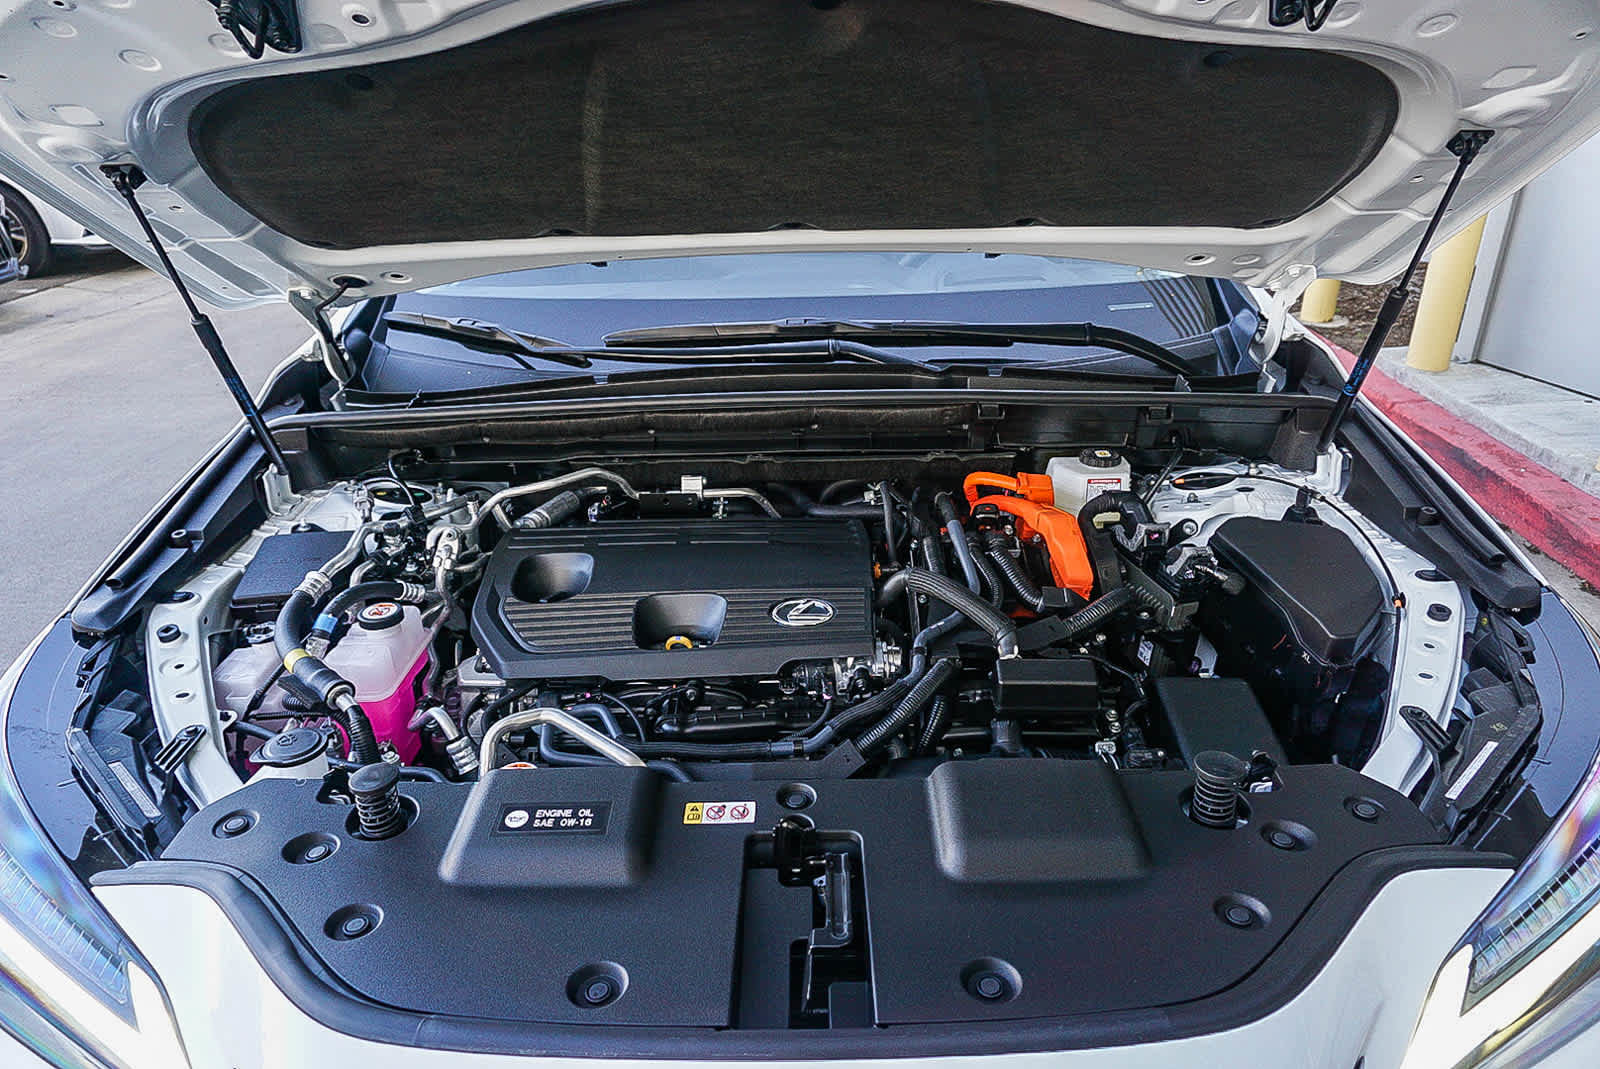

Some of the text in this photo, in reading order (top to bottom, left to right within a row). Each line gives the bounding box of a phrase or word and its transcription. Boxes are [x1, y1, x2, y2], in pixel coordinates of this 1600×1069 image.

[535, 808, 594, 818] ENGINE OIL
[533, 819, 555, 828] SAE
